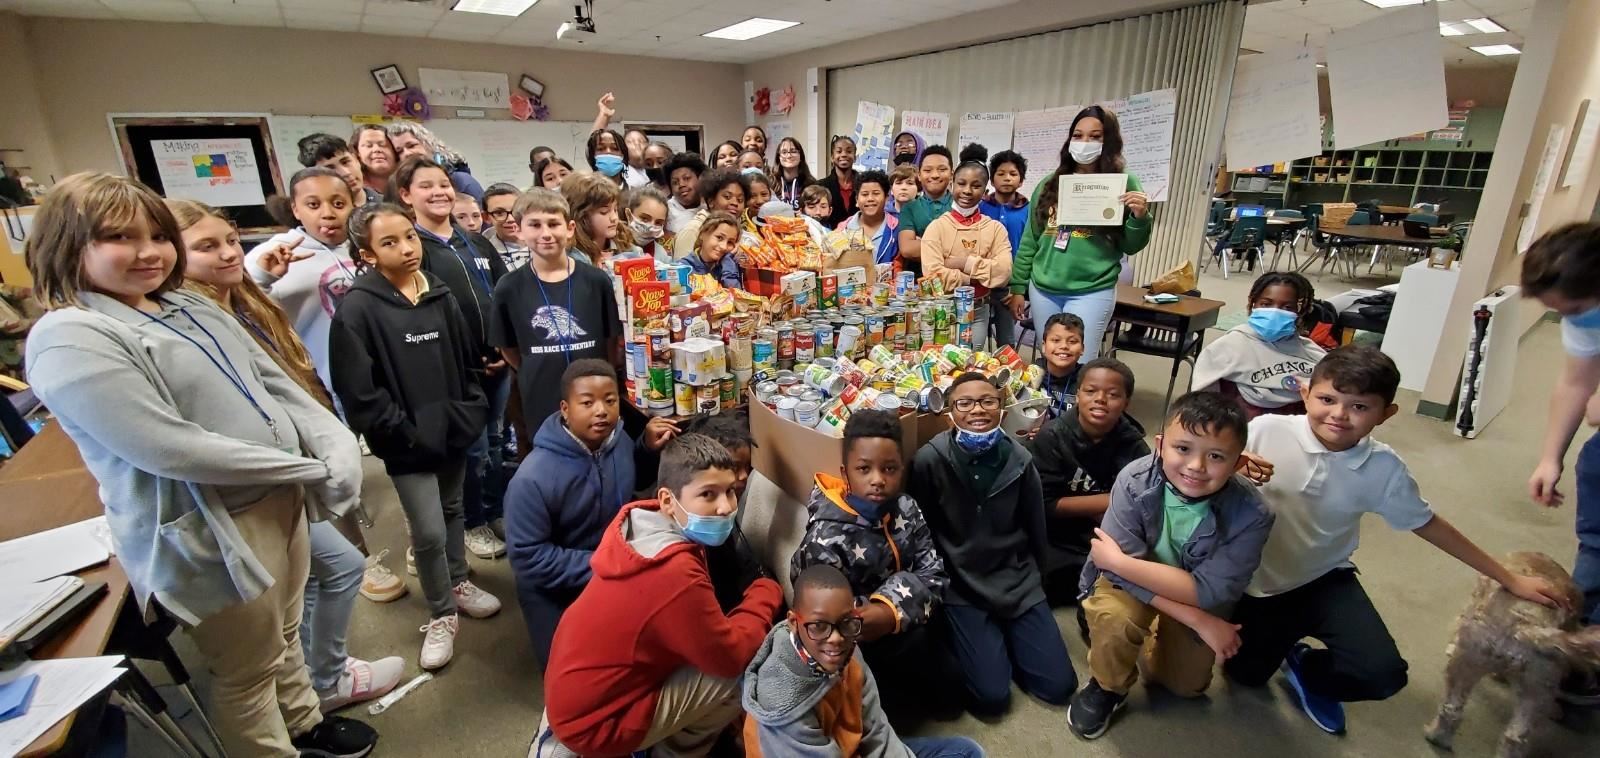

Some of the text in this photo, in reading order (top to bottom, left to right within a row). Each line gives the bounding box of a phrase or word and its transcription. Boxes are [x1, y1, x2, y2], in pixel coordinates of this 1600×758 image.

[925, 117, 943, 129] IDEA
[627, 266, 651, 283] Stove
[636, 289, 665, 308] Stove
[644, 300, 661, 312] Top
[405, 331, 439, 344] Supreme
[544, 345, 560, 353] RACE
